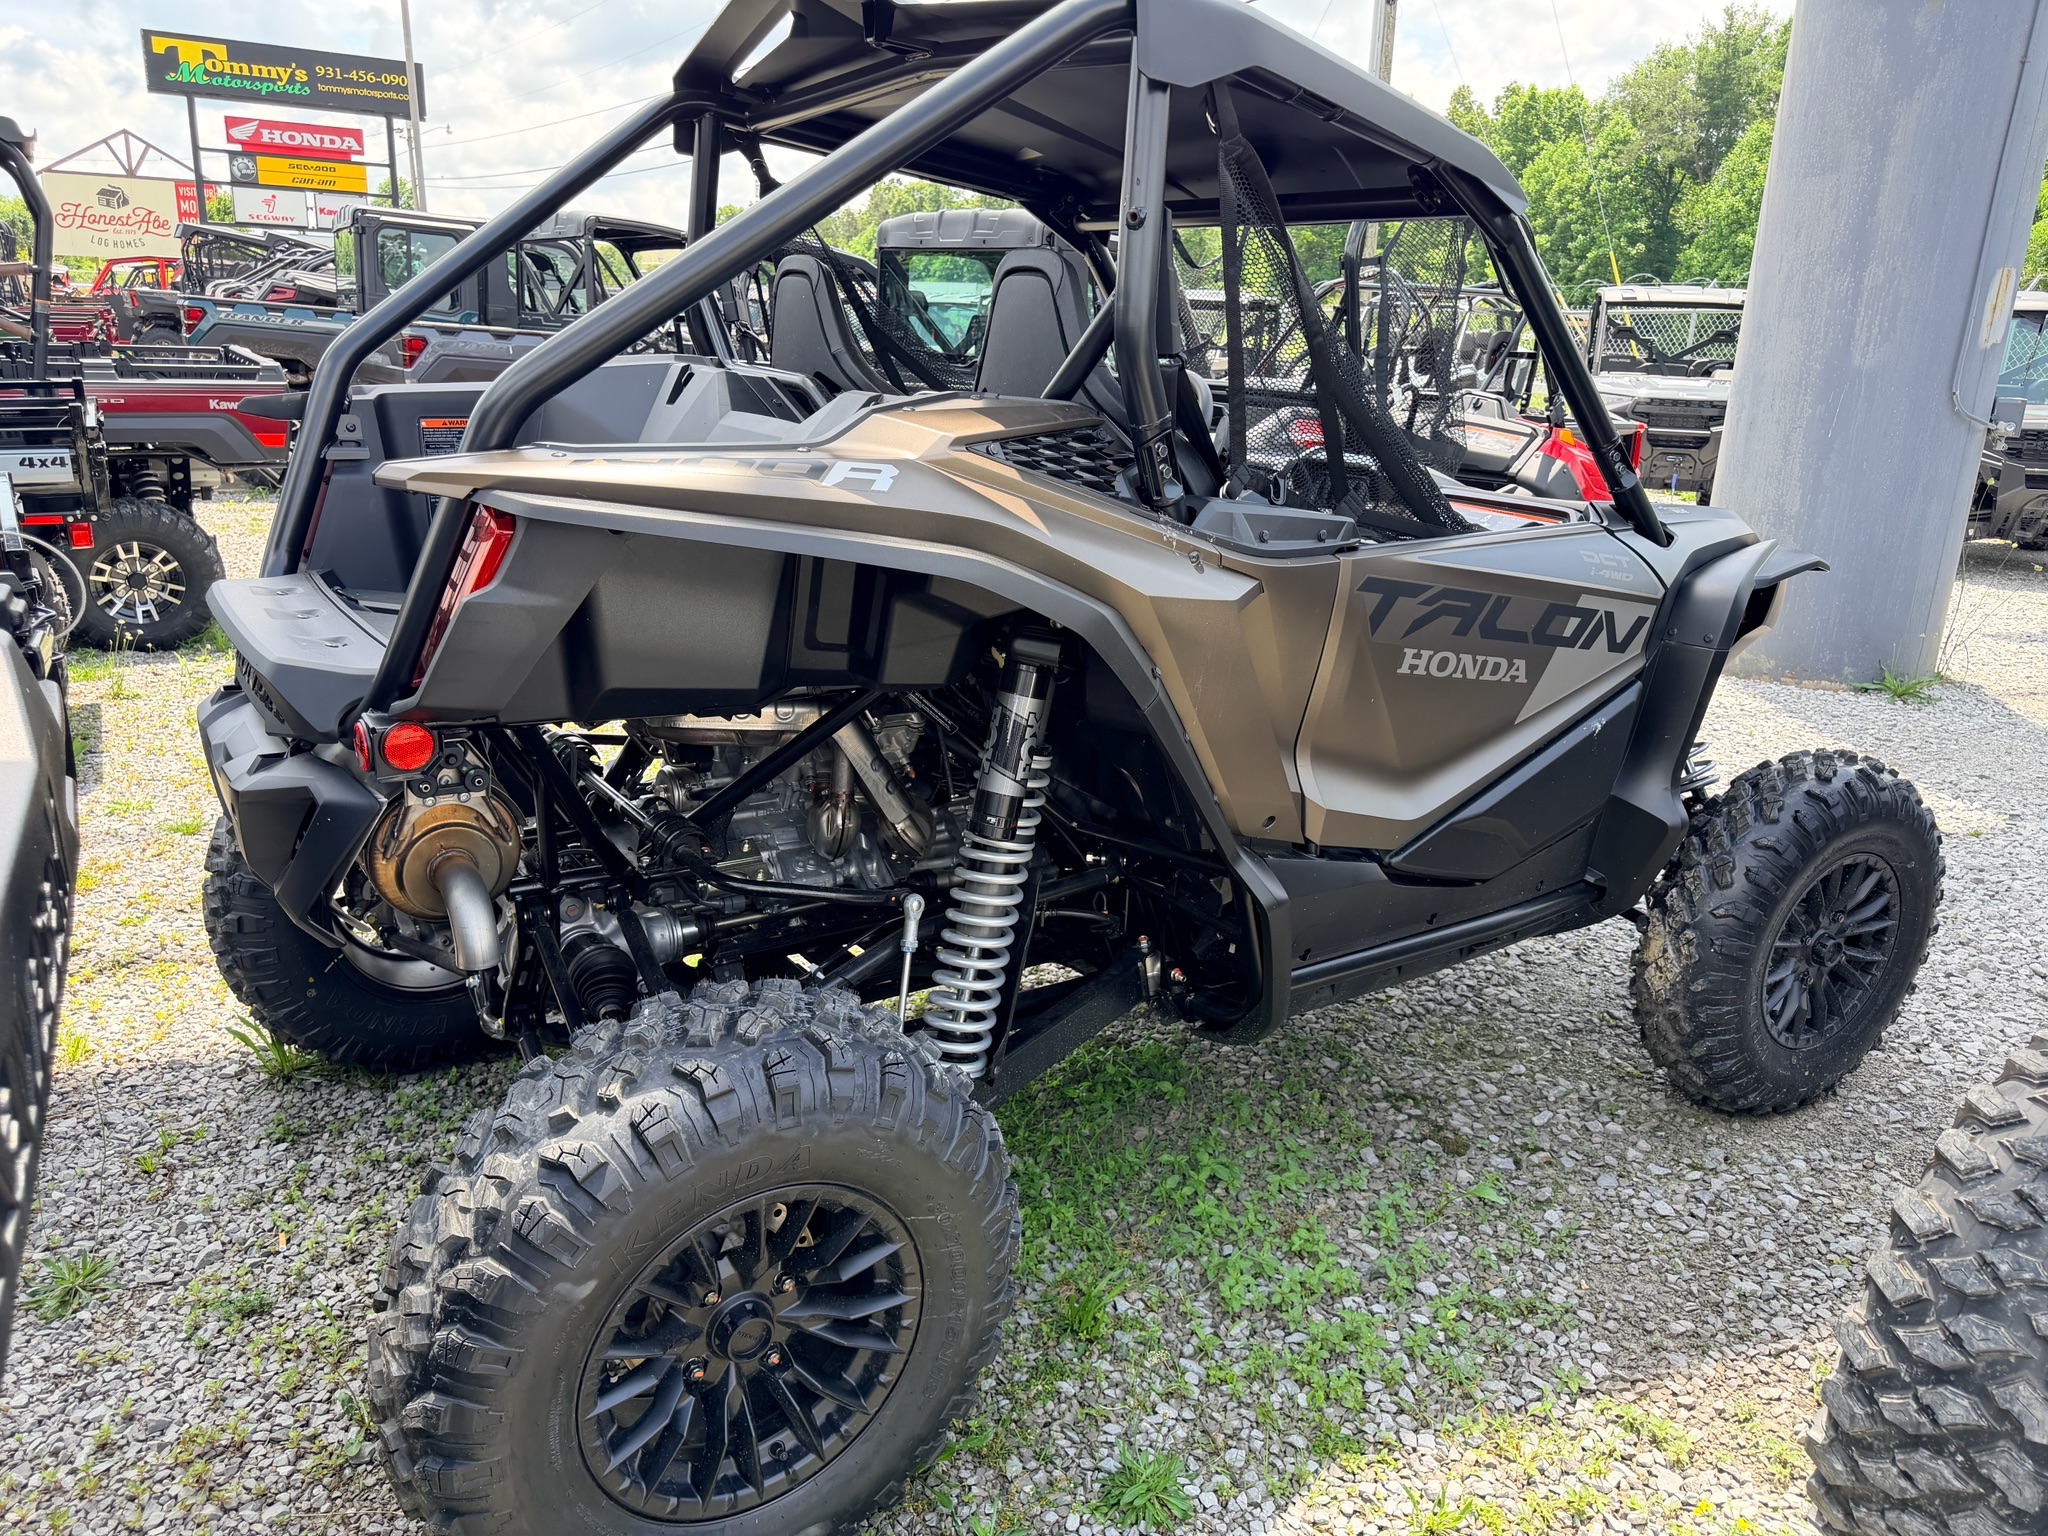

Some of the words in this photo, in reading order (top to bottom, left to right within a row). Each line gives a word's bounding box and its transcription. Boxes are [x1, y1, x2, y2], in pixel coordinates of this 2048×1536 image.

[151, 36, 308, 86] Tommy's
[165, 62, 310, 95] Motorsports
[315, 65, 408, 87] 931-456-090
[317, 83, 409, 101] tommysmotorsports.co
[260, 128, 362, 151] HONDA
[55, 202, 132, 233] Honest
[132, 206, 172, 237] Abe
[248, 213, 296, 223] SEGWAY
[91, 234, 109, 247] LOG
[113, 237, 146, 249] HOMES
[222, 312, 305, 326] RANGER
[19, 456, 68, 469] 4x4
[1579, 550, 1630, 568] DCT
[1356, 575, 1650, 654] TALON
[1397, 648, 1528, 684] HONDA
[609, 1144, 811, 1274] KENDA
